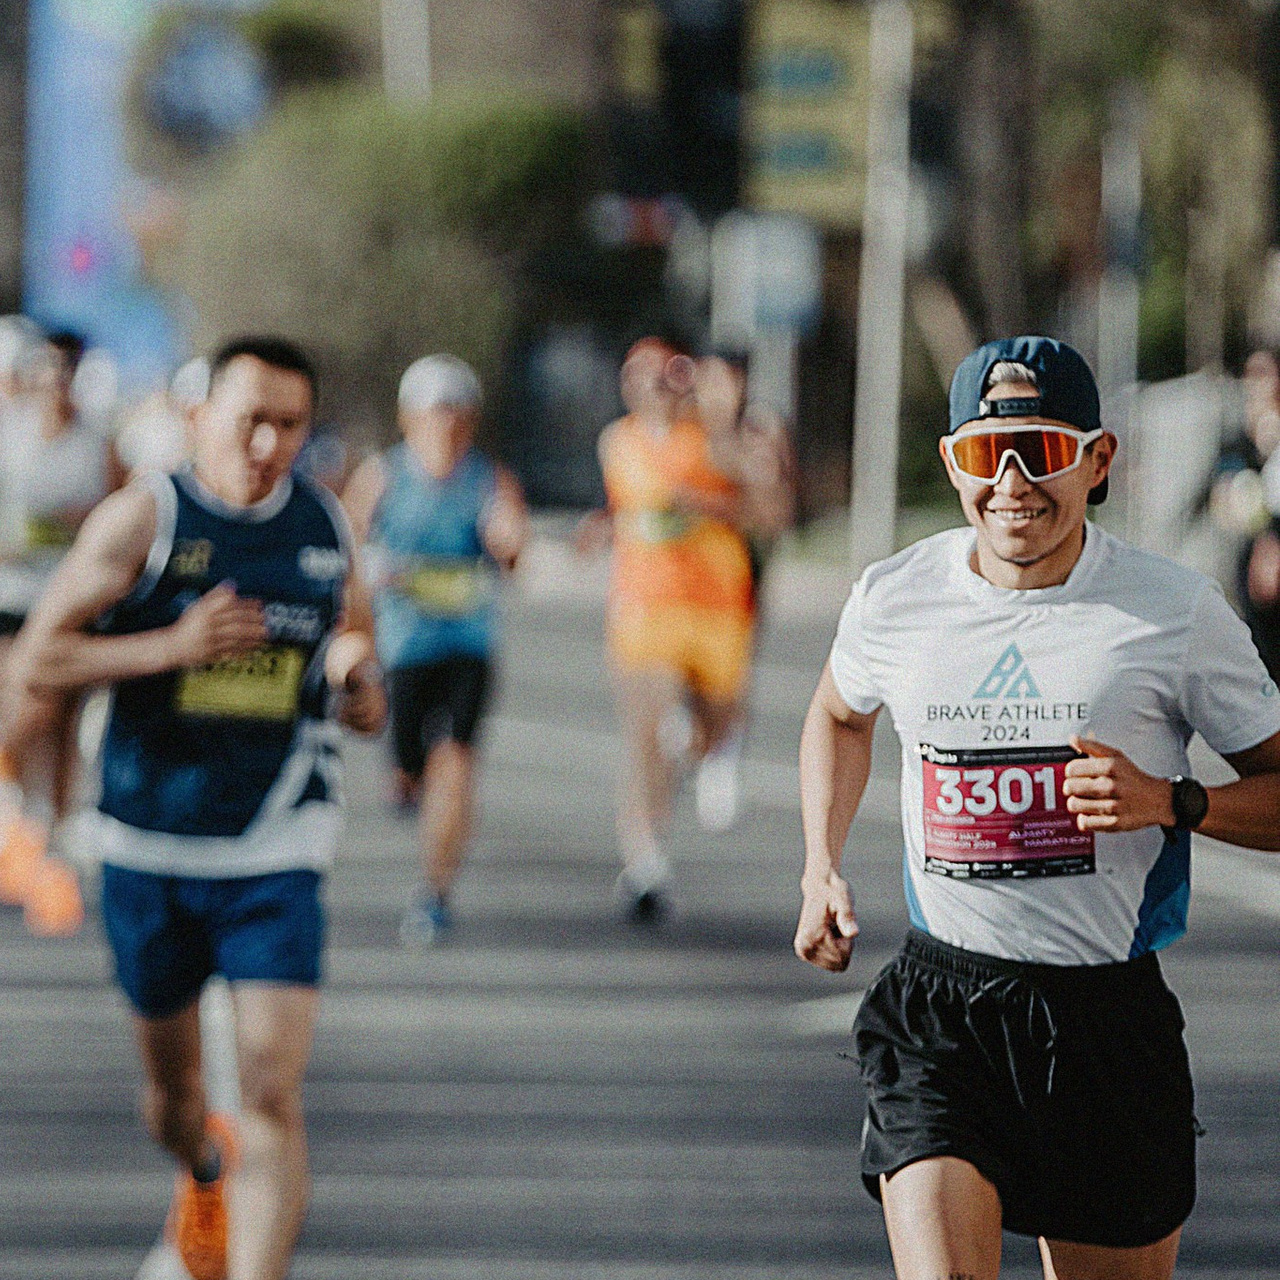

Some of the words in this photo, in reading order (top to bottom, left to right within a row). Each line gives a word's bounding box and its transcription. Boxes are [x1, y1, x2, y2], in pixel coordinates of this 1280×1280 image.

[927, 704, 992, 721] BRAVE
[999, 702, 1089, 721] ATHLETE
[982, 725, 1031, 742] 2024
[935, 766, 1057, 816] 3301
